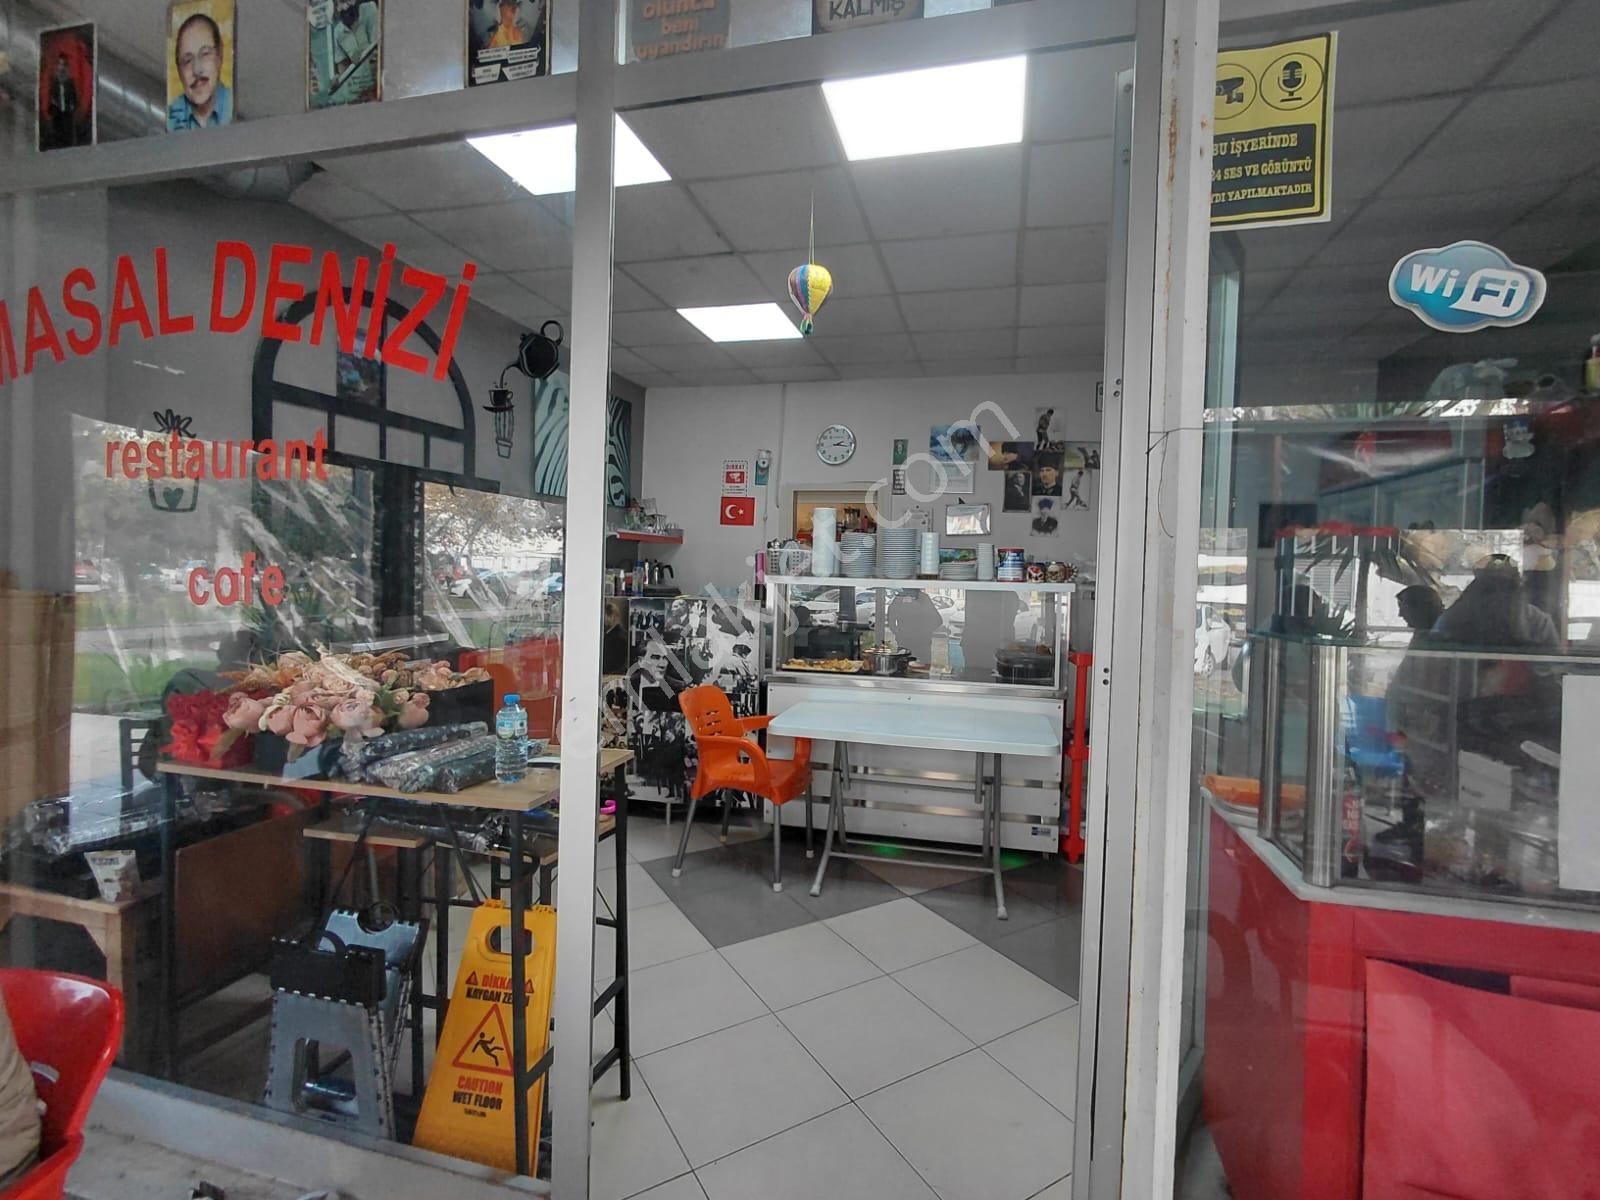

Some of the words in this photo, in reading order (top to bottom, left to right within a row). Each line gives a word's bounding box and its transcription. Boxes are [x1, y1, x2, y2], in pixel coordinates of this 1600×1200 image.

[1223, 166, 1243, 180] SES
[1244, 164, 1260, 176] VE
[1260, 157, 1312, 175] GÖRÜNTÜ
[1227, 184, 1312, 201] YAPILMAKTADIR
[208, 240, 478, 383] DENİZİ
[104, 427, 328, 481] restaurant
[481, 973, 513, 990] DİKKA
[458, 1076, 503, 1094] CAUTION
[453, 1091, 472, 1104] WET
[474, 1094, 503, 1110] FLOOR
